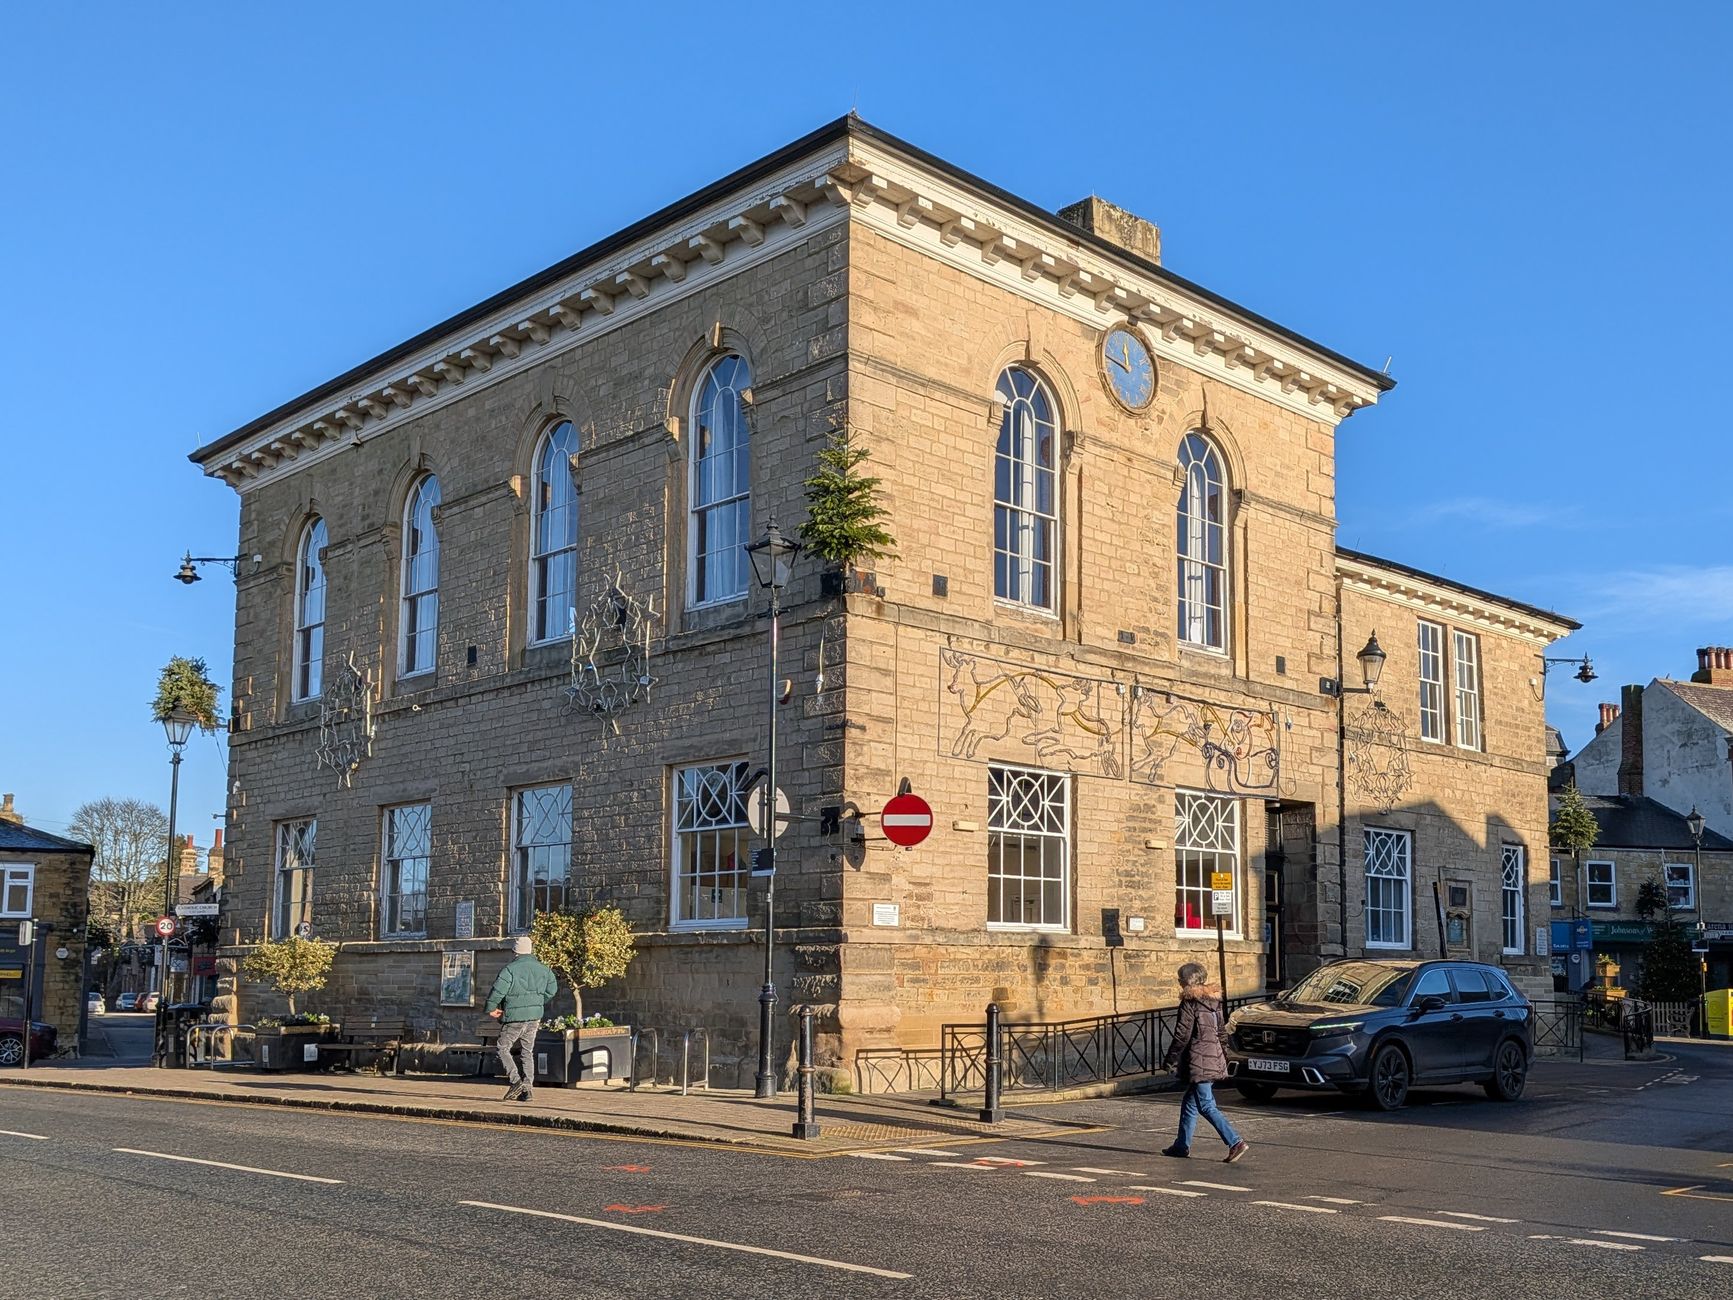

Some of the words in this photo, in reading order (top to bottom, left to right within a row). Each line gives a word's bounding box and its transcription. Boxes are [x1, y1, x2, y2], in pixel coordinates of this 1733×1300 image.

[160, 922, 173, 930] 20
[1252, 1060, 1272, 1070] YJ73
[1273, 1061, 1289, 1071] FSG
